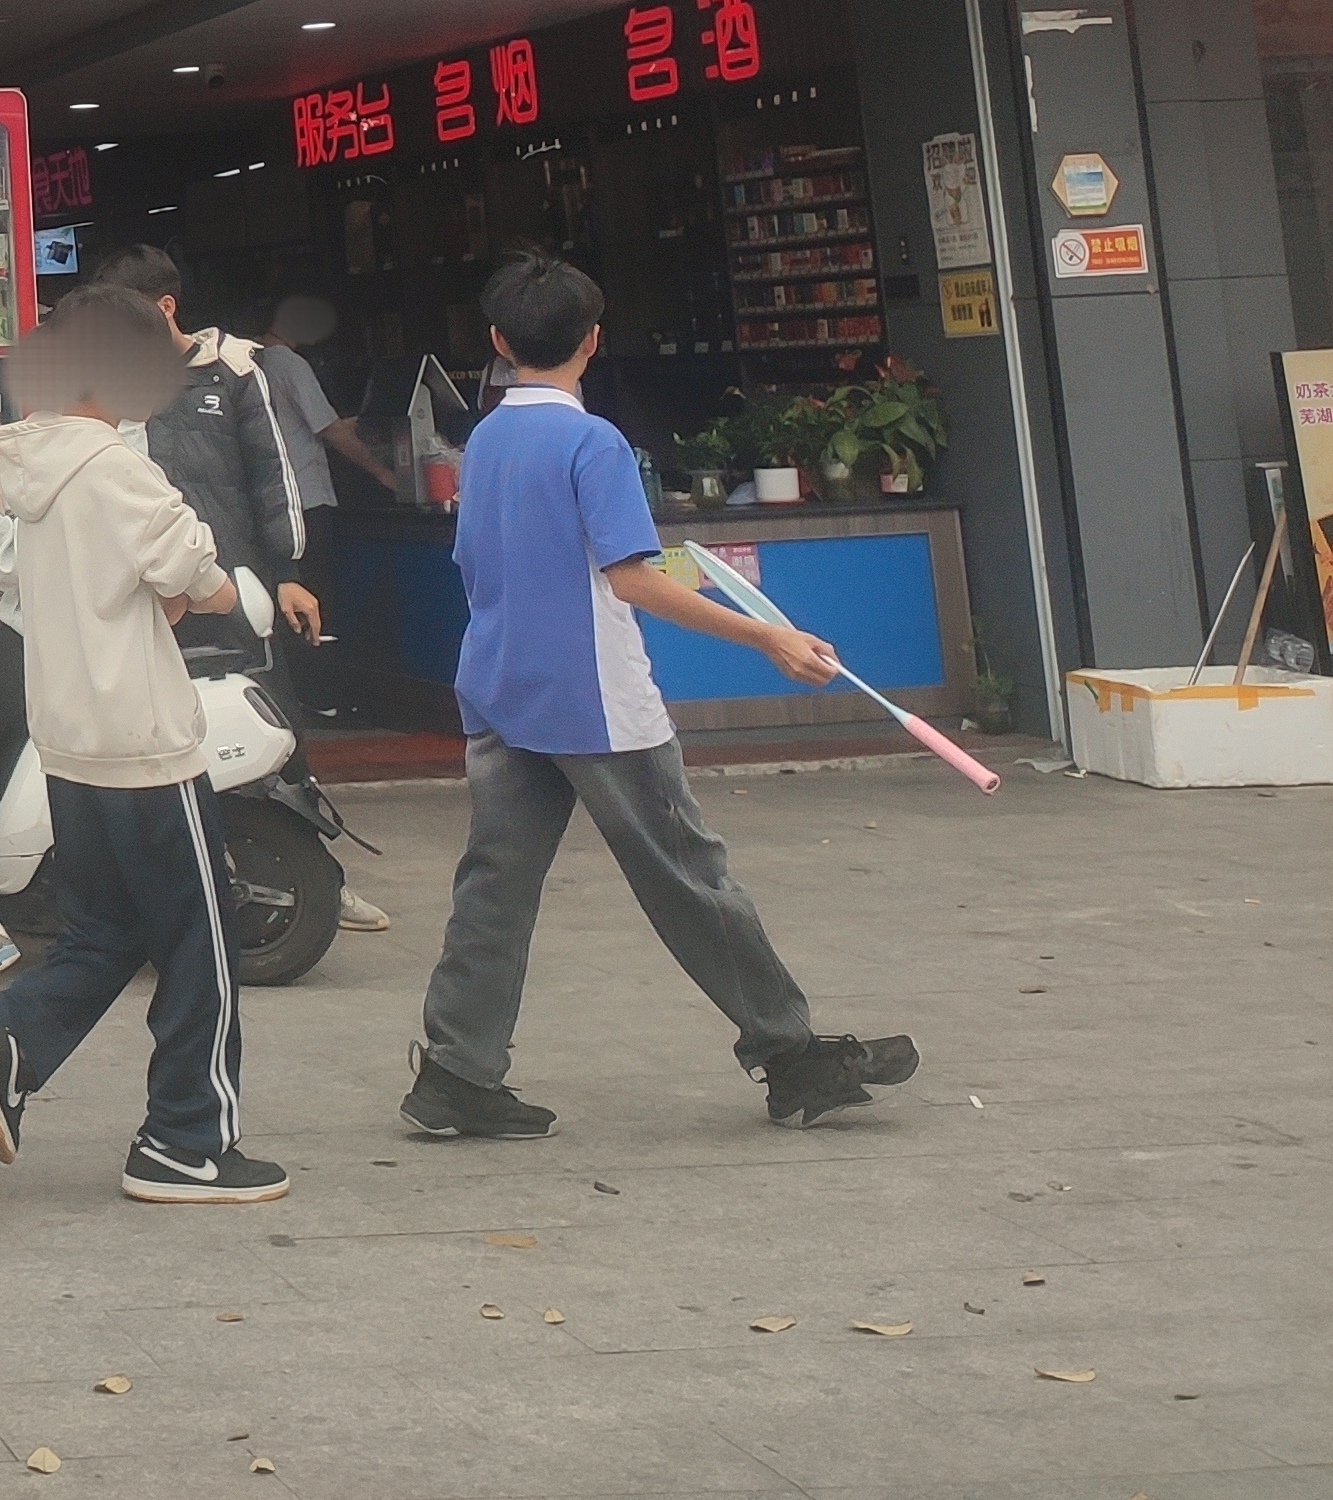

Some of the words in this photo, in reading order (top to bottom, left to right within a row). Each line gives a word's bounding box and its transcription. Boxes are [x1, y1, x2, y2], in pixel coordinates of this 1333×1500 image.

[292, 82, 394, 168] 服务台
[432, 37, 539, 143] 名烟
[1295, 383, 1333, 399] 奶茶
